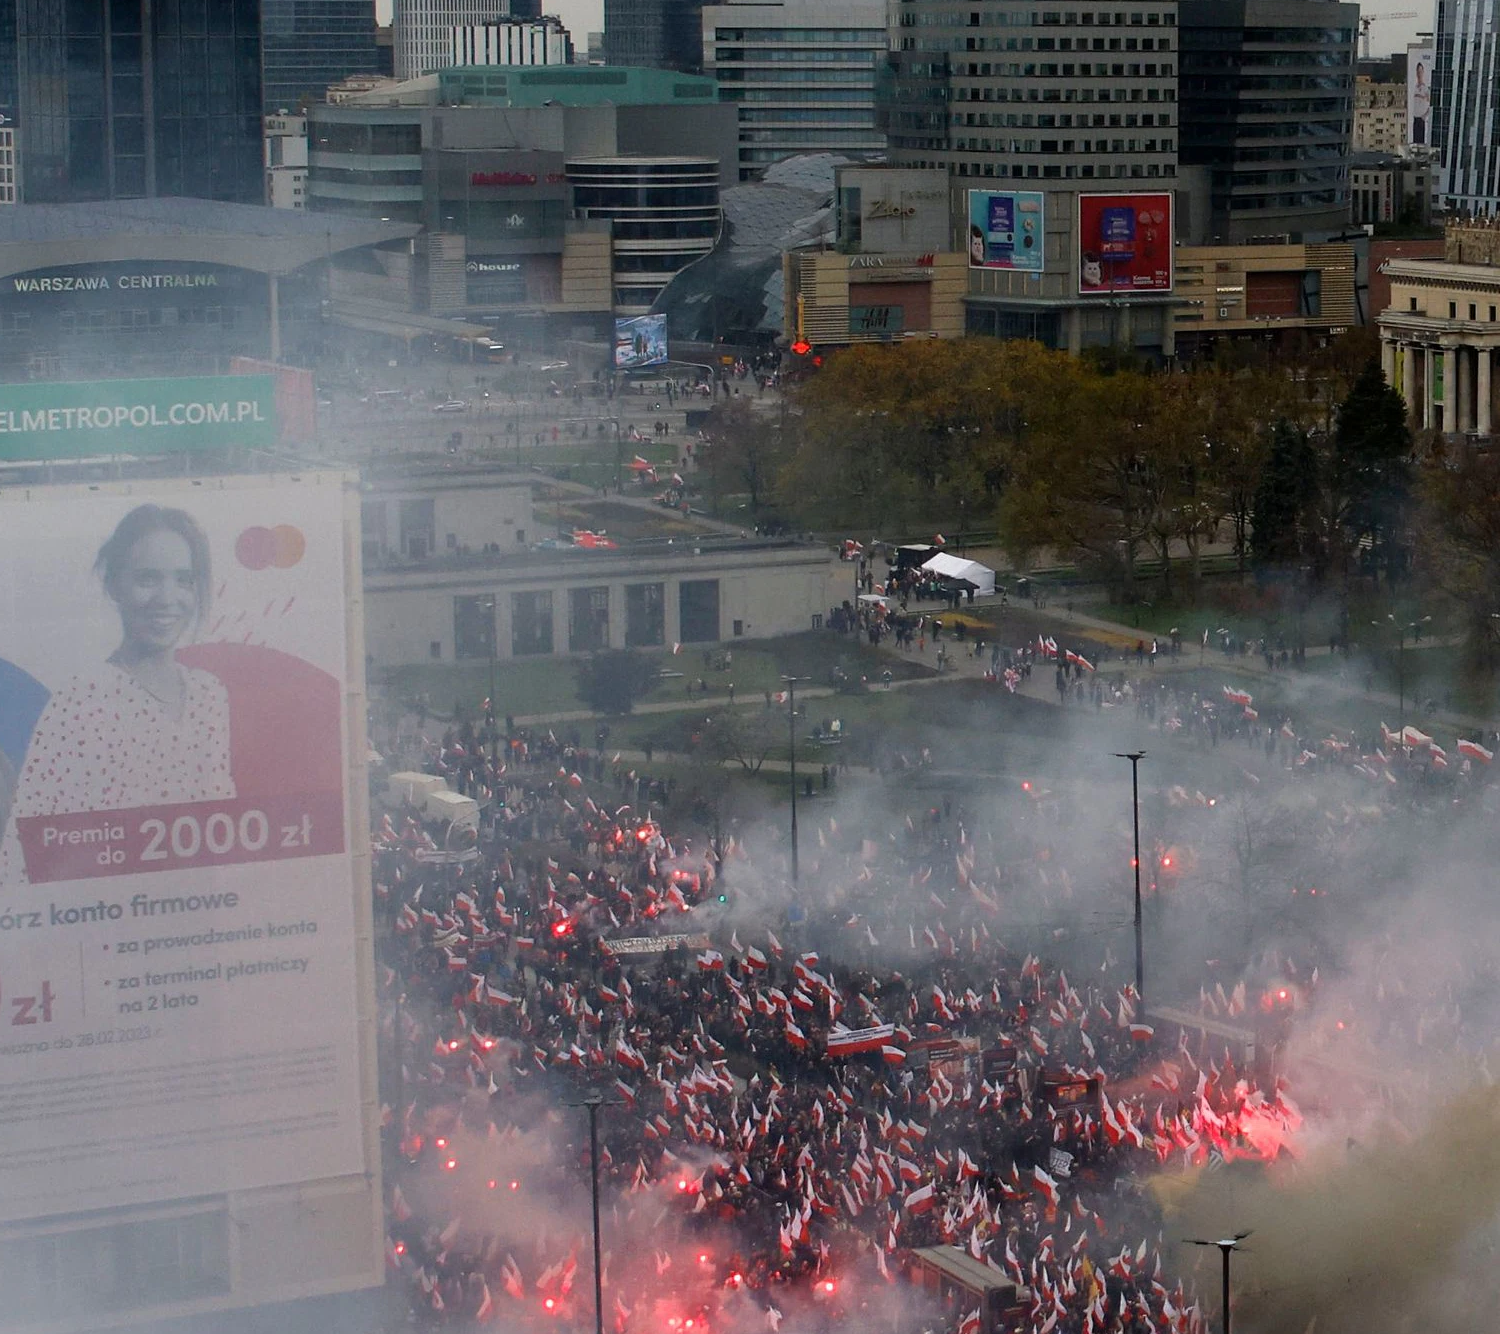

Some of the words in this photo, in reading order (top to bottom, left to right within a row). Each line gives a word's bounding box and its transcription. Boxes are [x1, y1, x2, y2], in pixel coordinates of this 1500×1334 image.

[479, 262, 520, 272] house
[13, 276, 110, 292] WARSZAWA
[118, 273, 219, 289] CENTRALNA
[43, 822, 125, 847] Premia
[140, 809, 270, 861] 2000
[280, 812, 314, 848] zł
[97, 845, 126, 865] do
[49, 900, 124, 927] konto
[130, 890, 240, 918] firmowe
[116, 939, 140, 954] za
[144, 927, 262, 957] prowadzenie
[267, 919, 319, 938] konta
[118, 975, 142, 989] za
[146, 962, 222, 988] terminal
[226, 957, 310, 982] płatniczy
[11, 980, 56, 1027] zł
[120, 1000, 143, 1014] na
[147, 995, 158, 1012] 2
[162, 993, 199, 1010] lata
[53, 1037, 73, 1050] do
